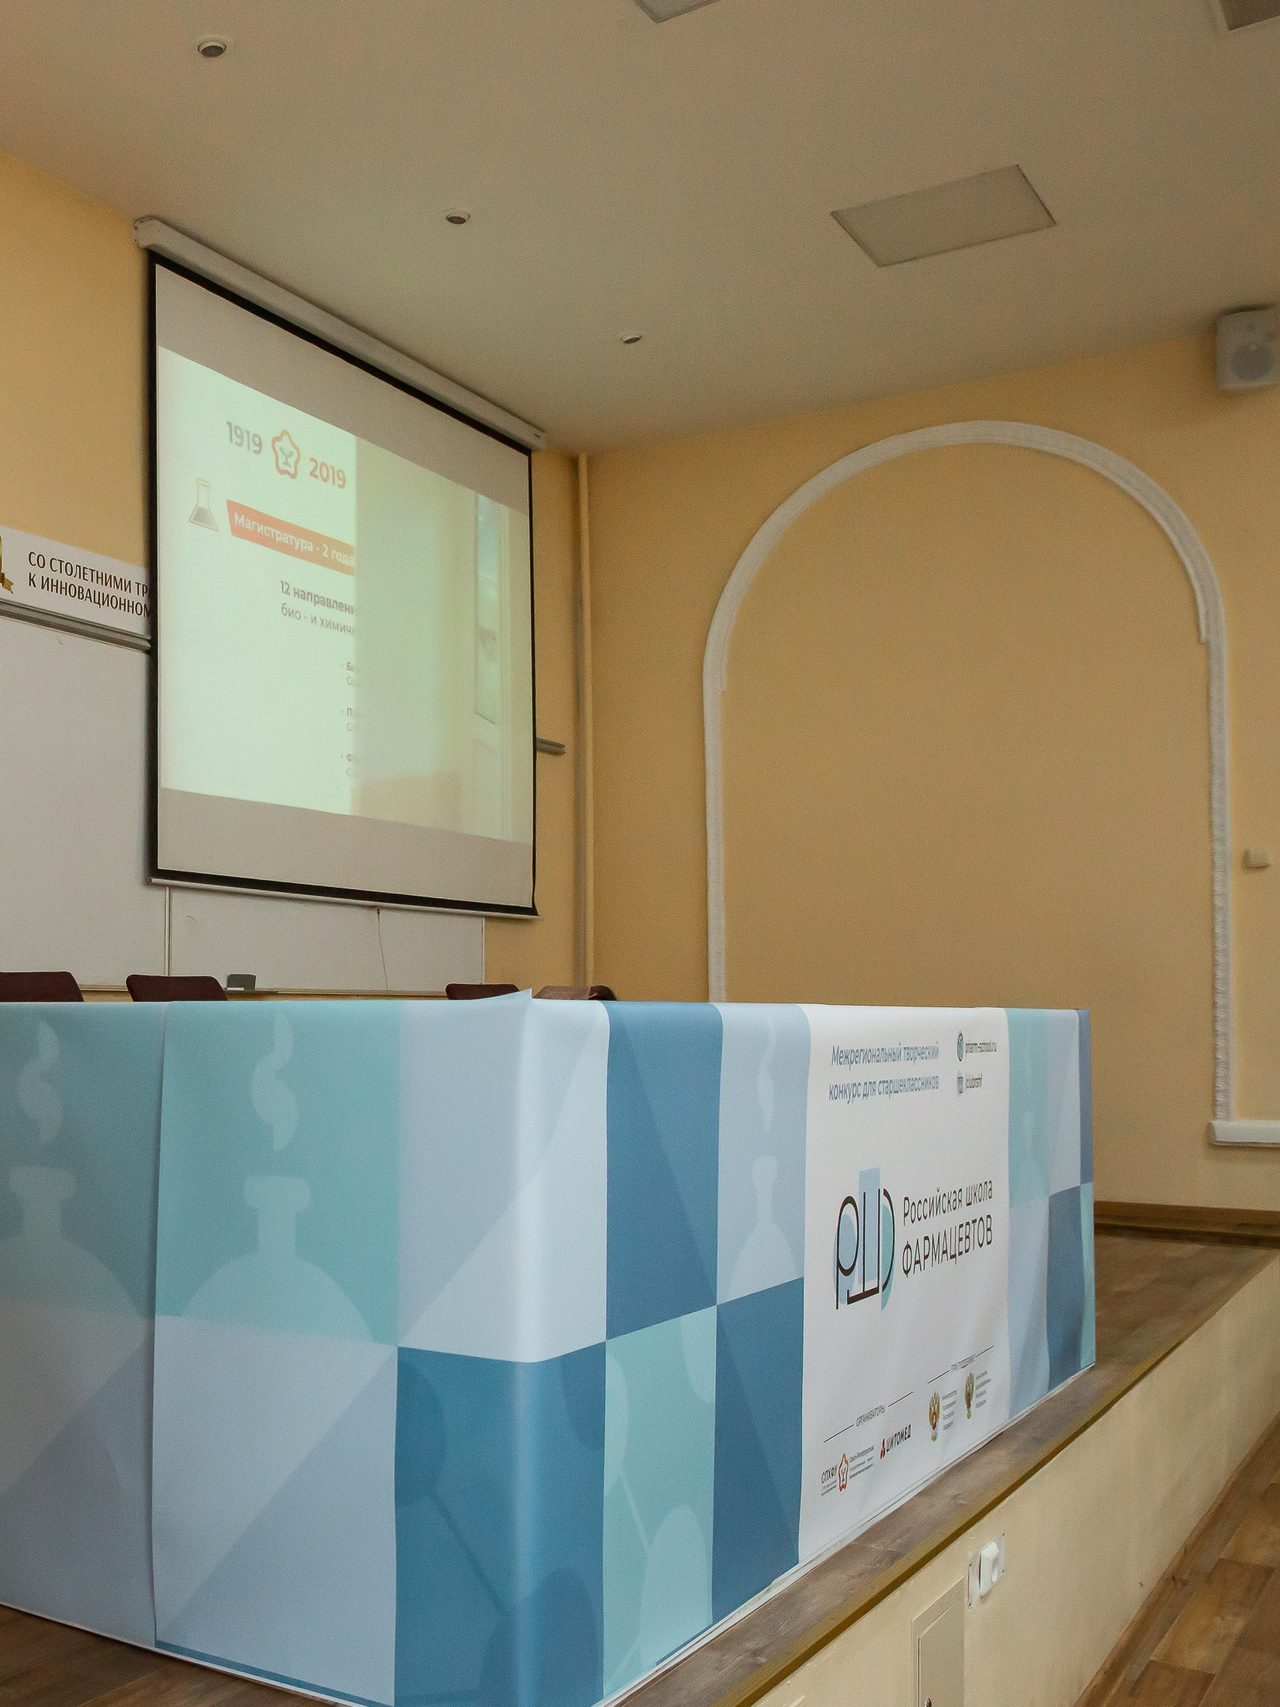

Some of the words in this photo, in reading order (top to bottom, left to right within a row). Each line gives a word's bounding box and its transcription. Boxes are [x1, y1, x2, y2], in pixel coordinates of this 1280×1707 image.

[226, 420, 263, 456] 1919
[309, 456, 347, 490] 2019
[233, 509, 314, 555] Магистратура
[322, 543, 329, 559] 2
[28, 551, 46, 569] СО
[49, 557, 132, 594] СТОЛЕТНИМИ
[28, 572, 37, 588] К
[280, 580, 291, 596] 12
[281, 602, 302, 620] био
[831, 1042, 902, 1069] Межрегиональный
[903, 1041, 940, 1063] творческий
[828, 1079, 862, 1104] конкурс
[862, 1078, 877, 1099] для
[877, 1073, 940, 1097] старшеклассников
[903, 1186, 963, 1227] Российская
[965, 1179, 994, 1208] школа
[901, 1213, 994, 1278] ФАРМАЦЕВТОВ
[886, 1424, 912, 1453] ЦИТОМЕД
